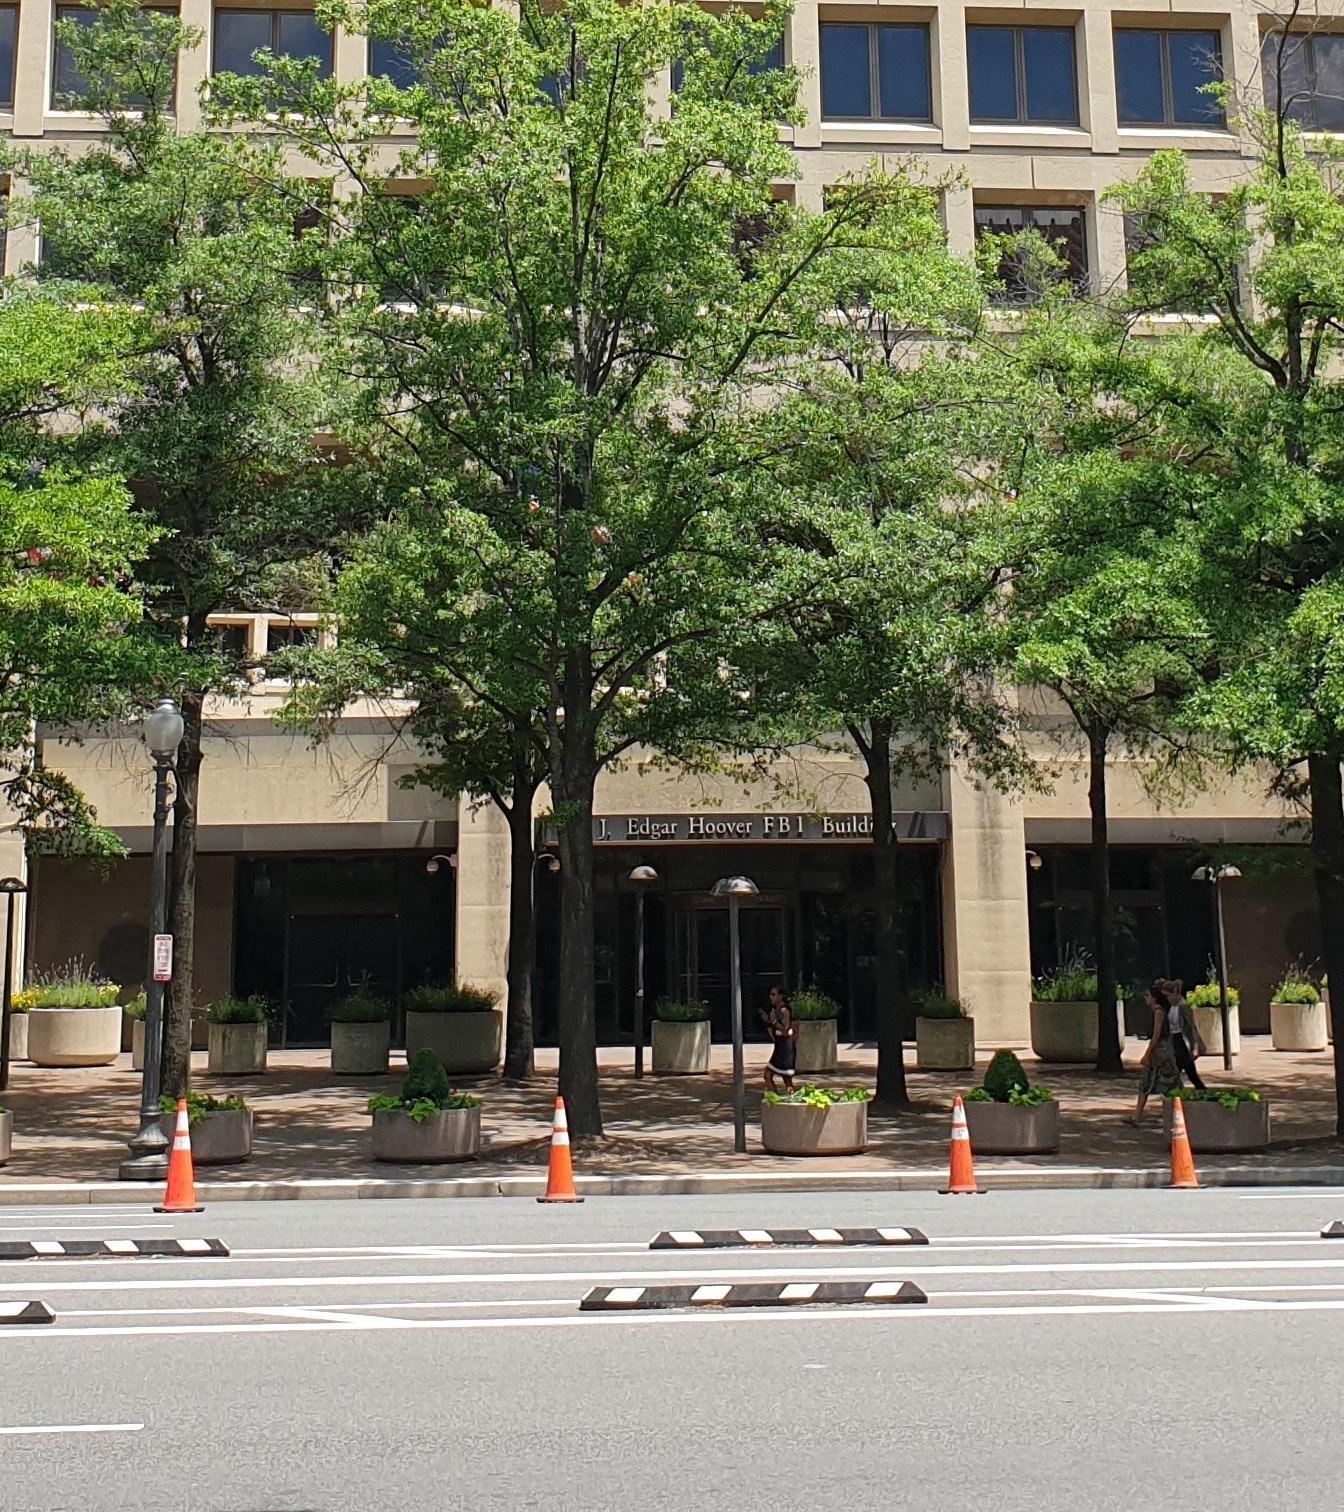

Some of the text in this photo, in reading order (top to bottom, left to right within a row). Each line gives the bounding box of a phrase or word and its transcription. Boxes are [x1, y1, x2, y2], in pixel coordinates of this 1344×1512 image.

[597, 818, 612, 840] J.
[627, 816, 678, 840] Edgar
[688, 816, 753, 834] Hoover
